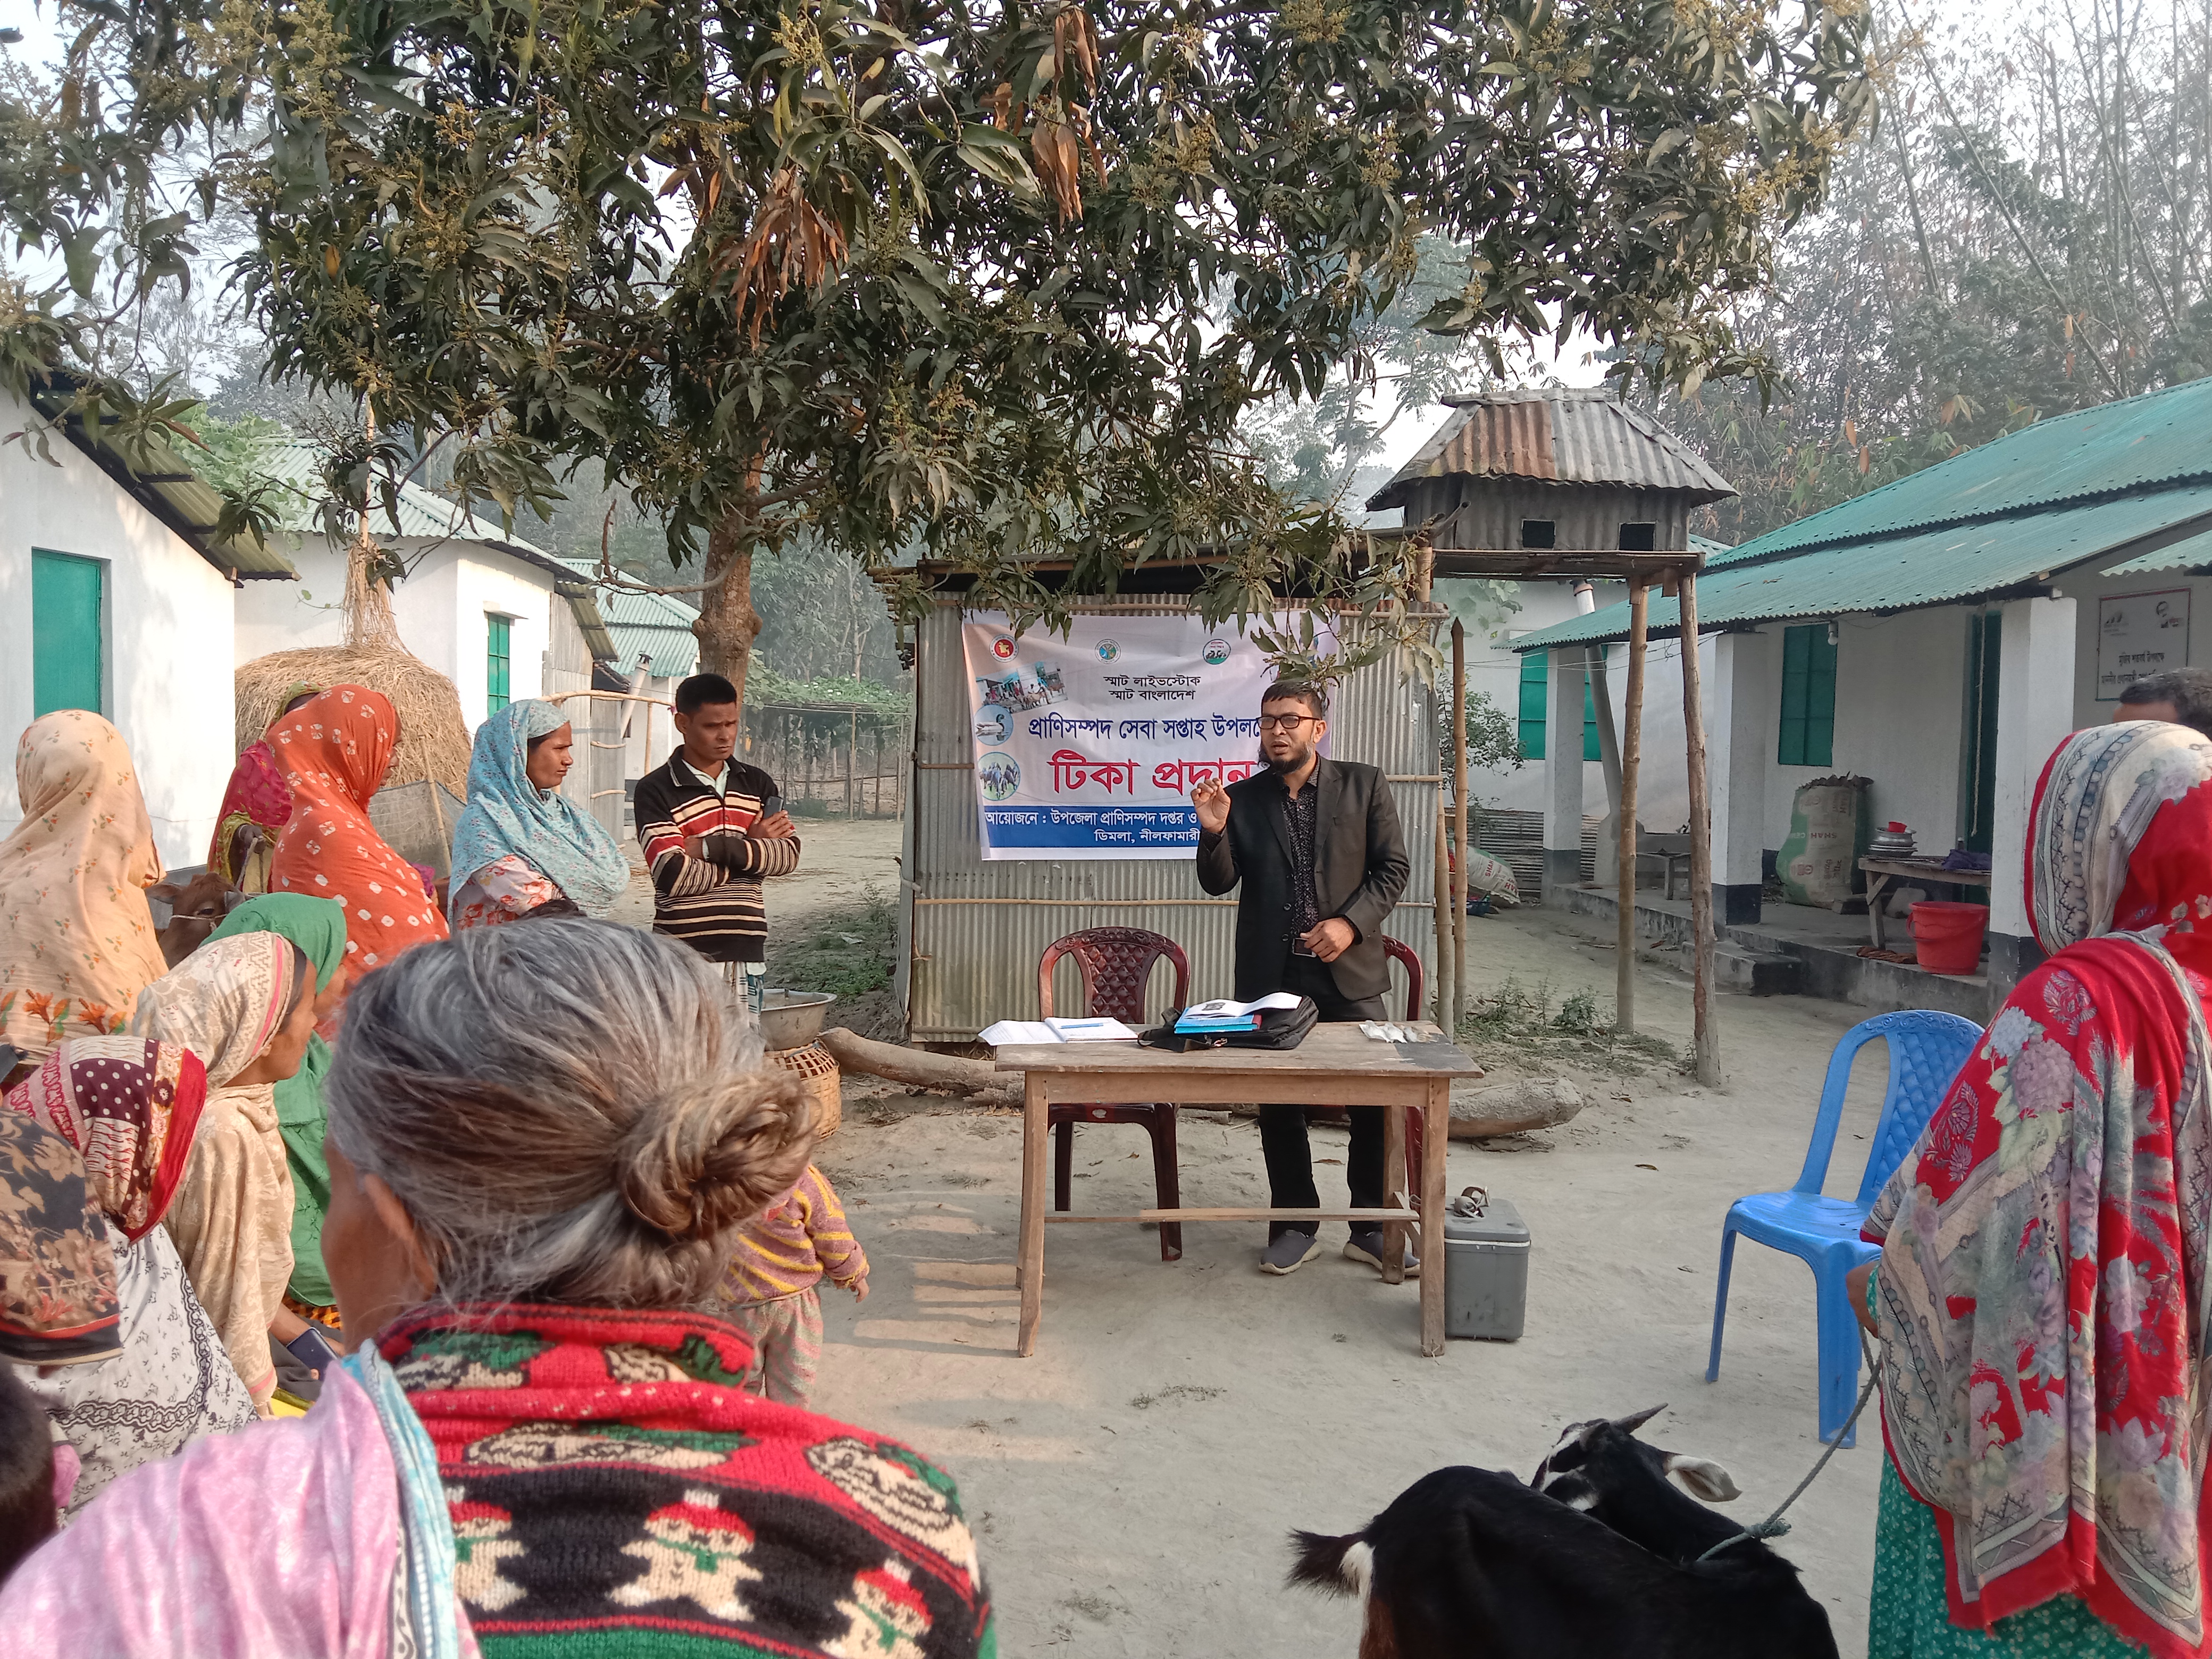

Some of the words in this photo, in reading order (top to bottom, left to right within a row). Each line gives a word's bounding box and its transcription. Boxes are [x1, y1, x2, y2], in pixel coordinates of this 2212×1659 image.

[1133, 674, 1201, 688] লাইভস্টোক
[1138, 690, 1196, 701] বাংলাদেশ
[1028, 711, 1113, 741] প্রাণিসম্পদ
[1119, 717, 1158, 740] সেবা
[1162, 717, 1208, 742] সপ্তাহ
[1046, 749, 1141, 795] টিকা
[984, 810, 1039, 825] আয়োজনে
[1050, 808, 1098, 825] উপজেলা
[1100, 808, 1157, 826] প্রাণিসম্পদ
[1159, 811, 1185, 825] দপ্তর
[1094, 828, 1135, 844] ডিমলা,
[1139, 827, 1201, 842] নীলফামারী
[1485, 860, 1494, 877] SHAH
